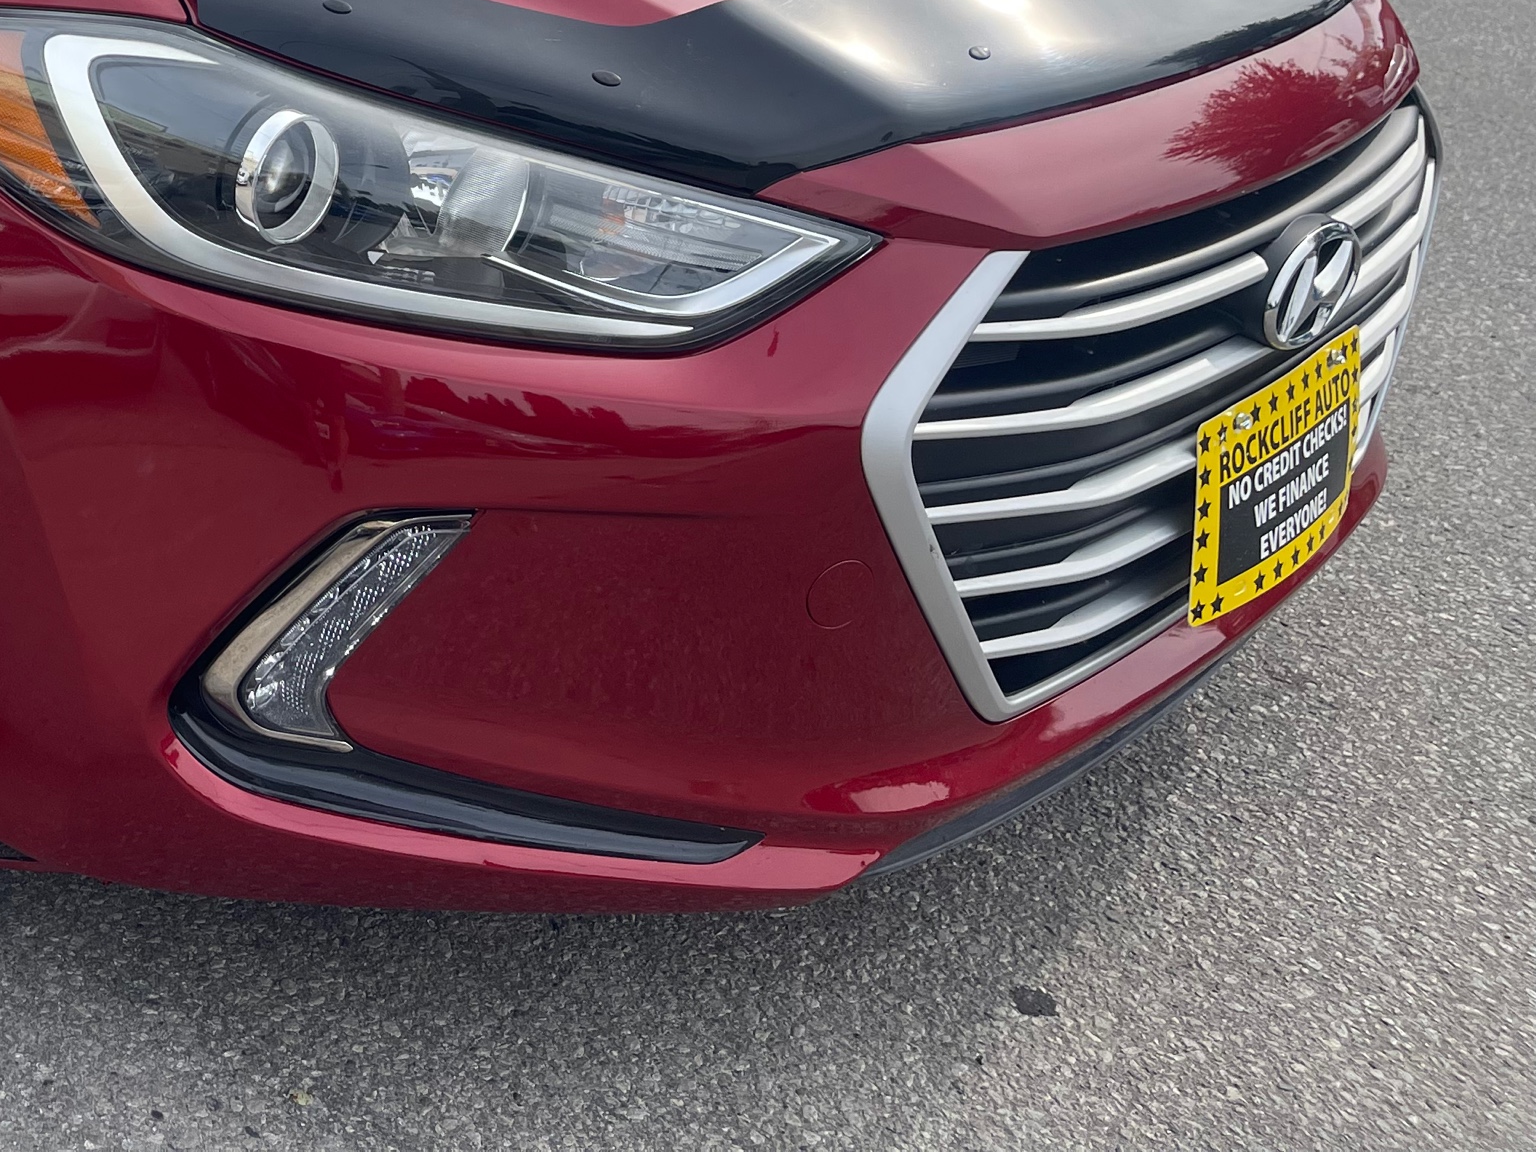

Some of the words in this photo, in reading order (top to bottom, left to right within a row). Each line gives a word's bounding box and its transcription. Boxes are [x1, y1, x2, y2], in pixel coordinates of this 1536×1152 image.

[1218, 397, 1313, 484] ROCKCLIFF
[1314, 369, 1351, 422] AUTO
[1227, 477, 1252, 510] NO
[1253, 439, 1302, 499] CREDIT
[1302, 403, 1348, 460] CHECKS!
[1253, 496, 1277, 529] WE
[1278, 453, 1330, 513] FINANCE
[1259, 487, 1328, 560] EVERYONE!
